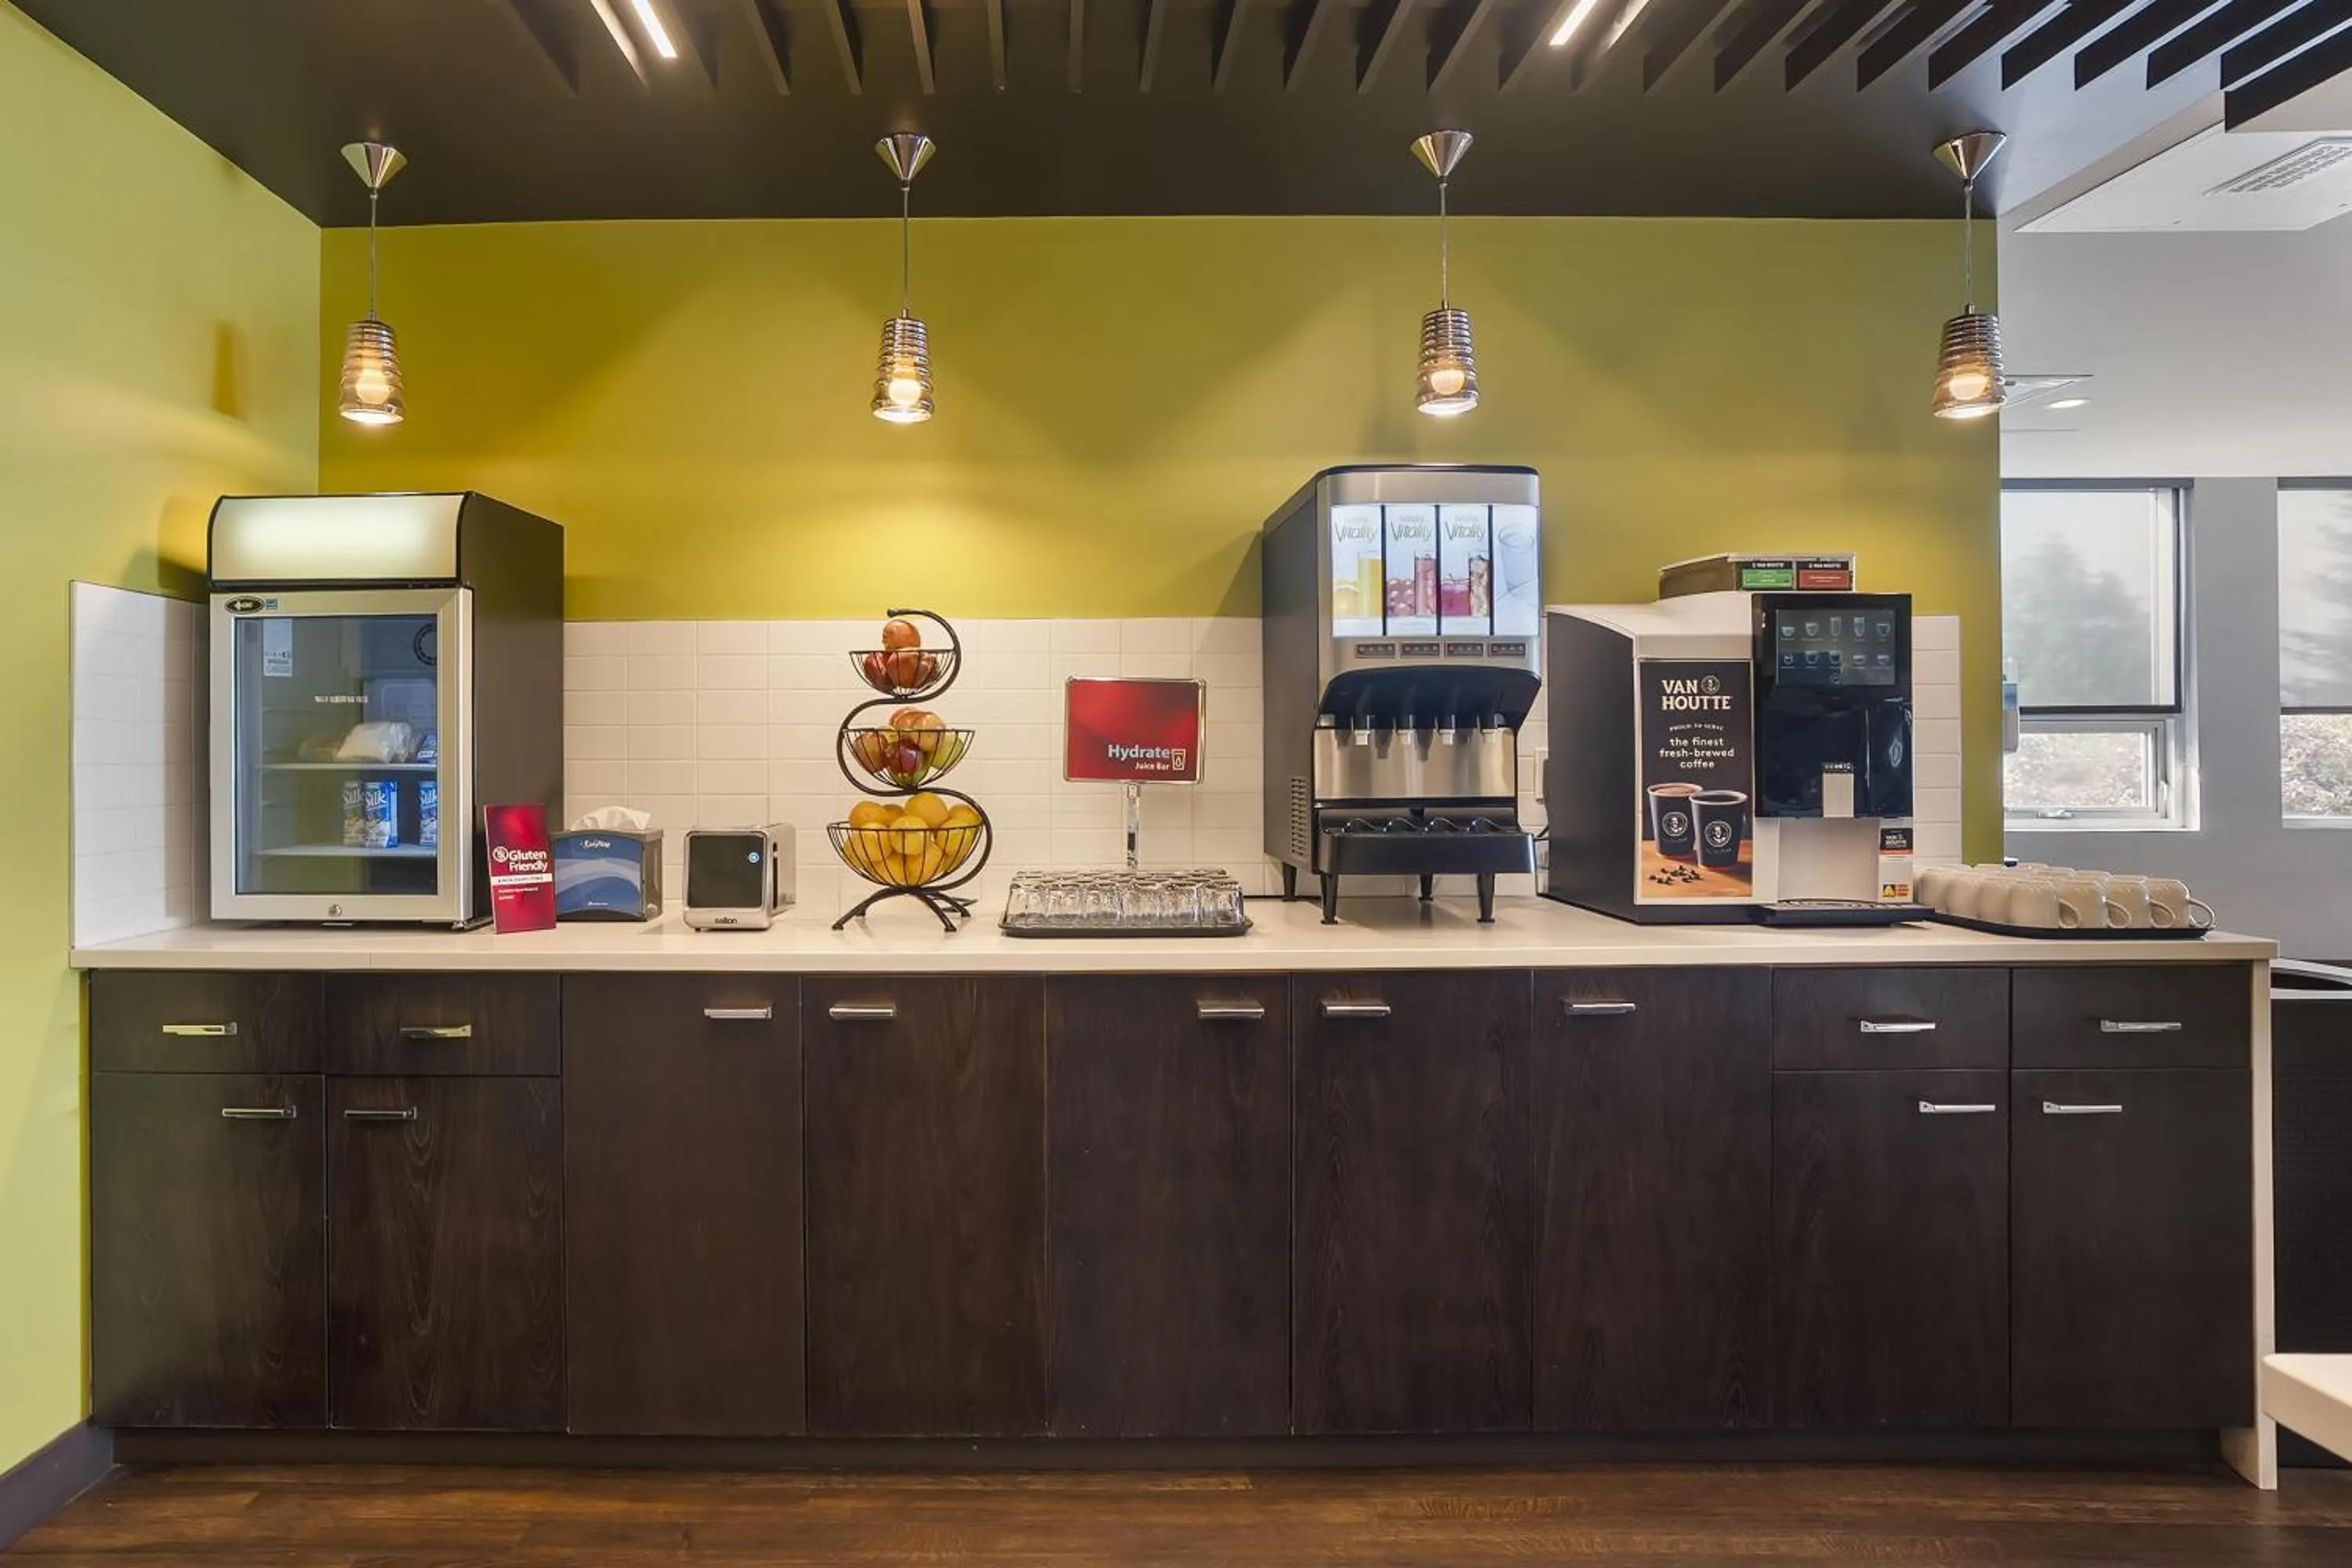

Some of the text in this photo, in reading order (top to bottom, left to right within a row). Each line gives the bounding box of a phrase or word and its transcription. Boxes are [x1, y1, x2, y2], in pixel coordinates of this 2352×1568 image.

[1334, 522, 1377, 543] Vitality
[1390, 521, 1432, 542] Vitality
[1445, 521, 1486, 541] Vitality
[1661, 679, 1698, 695] VAN
[1661, 695, 1731, 710] HOUTTE
[1669, 736, 1725, 747] the finest
[1108, 744, 1171, 761] Hydrate
[1659, 747, 1735, 758] fresh-brewed
[1679, 758, 1715, 769] coffee
[365, 789, 390, 808] Silk
[509, 849, 547, 862] Gluten
[509, 859, 549, 873] Friendly
